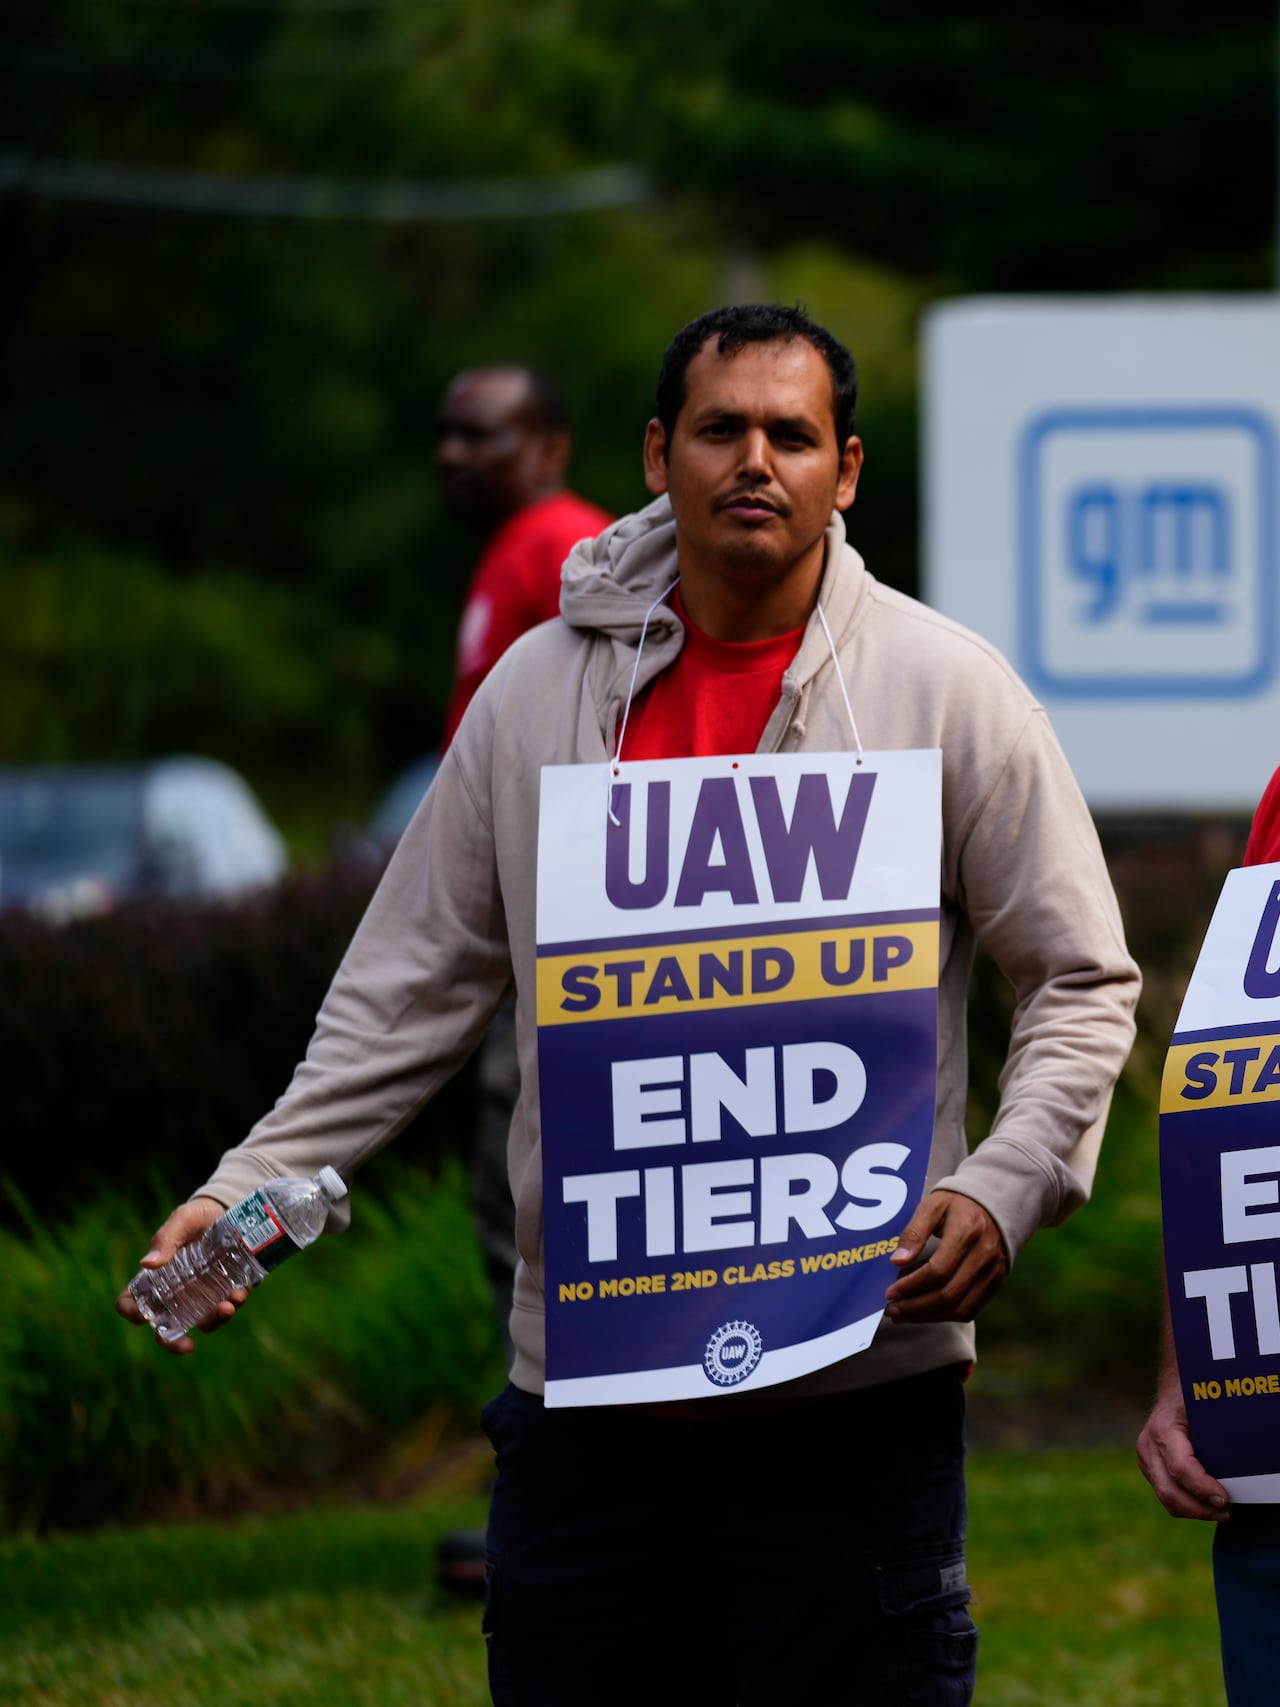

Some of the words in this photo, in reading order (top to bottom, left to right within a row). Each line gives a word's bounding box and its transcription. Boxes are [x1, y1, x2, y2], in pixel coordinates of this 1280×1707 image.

[1066, 478, 1236, 628] gm
[606, 772, 878, 911] UAW
[560, 947, 795, 1013] STAND
[820, 935, 914, 987] UP
[611, 1041, 868, 1151] END
[562, 1142, 911, 1263] TIERS
[558, 1281, 594, 1303] NO
[600, 1275, 667, 1299] MORE
[671, 1270, 719, 1291] 2ND
[723, 1259, 796, 1285] CLASS
[799, 1236, 900, 1275] WORKERS
[721, 1344, 746, 1361] UAW
[1192, 1381, 1222, 1401] NO
[1225, 1374, 1280, 1398] MORE
